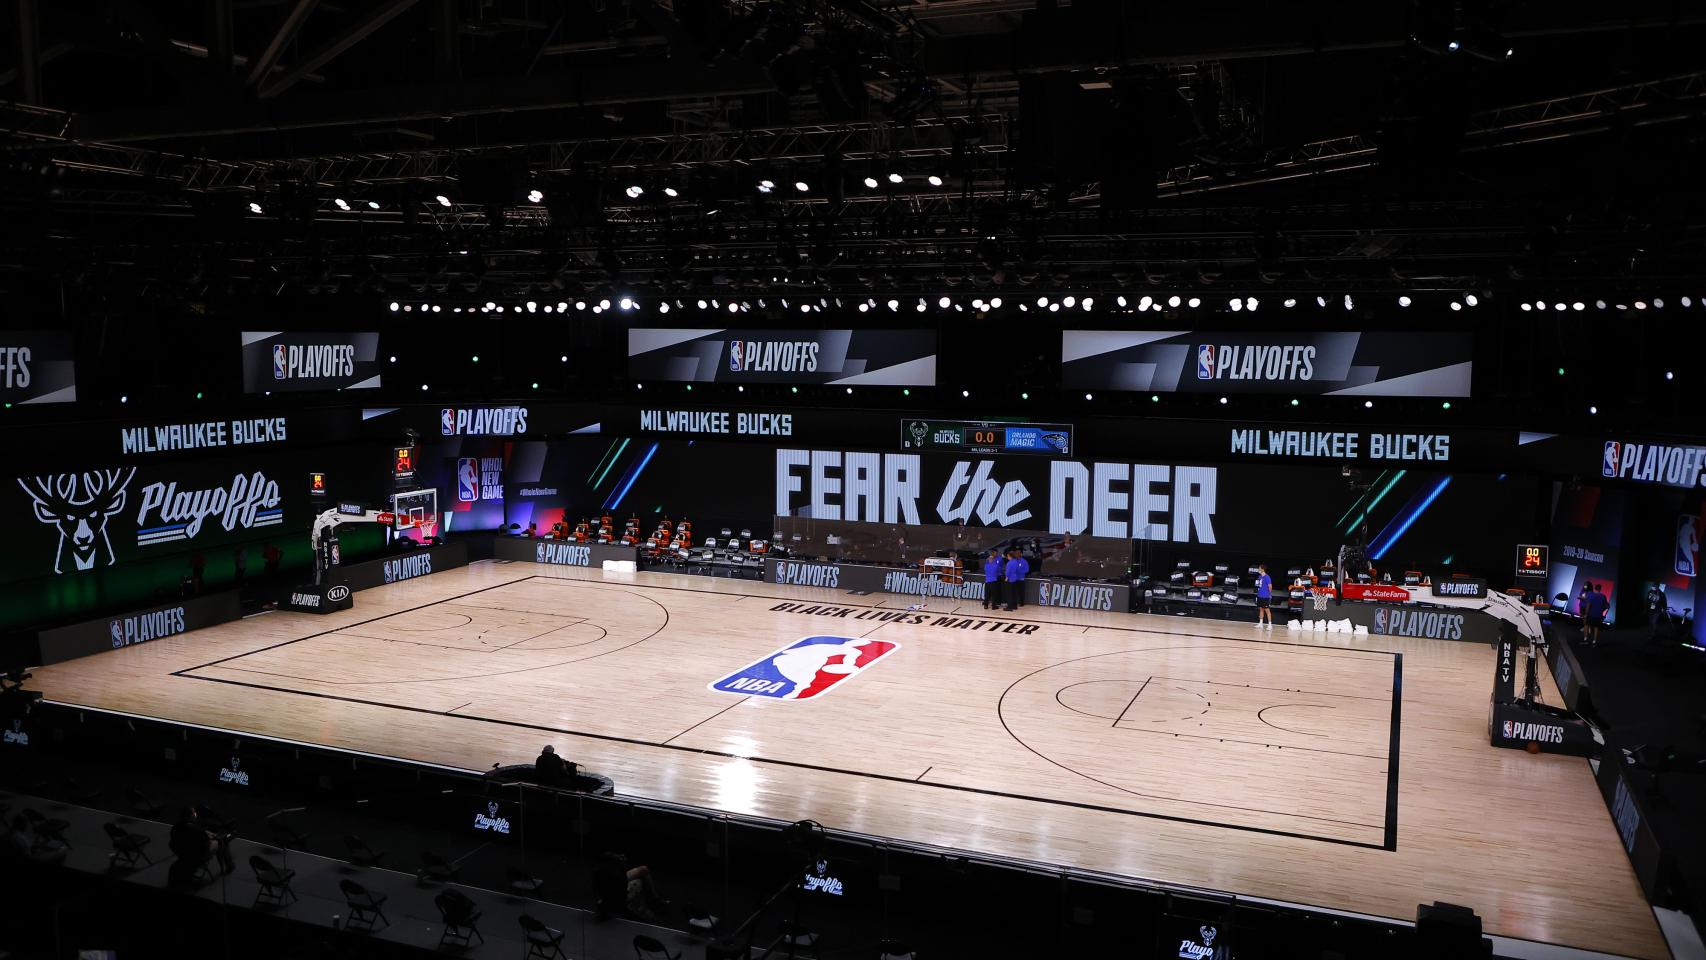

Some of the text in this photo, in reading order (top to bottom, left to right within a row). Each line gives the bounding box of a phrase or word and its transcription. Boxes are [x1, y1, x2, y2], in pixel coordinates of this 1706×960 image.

[288, 345, 354, 378] PLAYOFFS
[744, 341, 819, 372] PLAYOFFS
[1216, 346, 1316, 380] PLAYOFFS
[456, 408, 528, 435] PLAYOFFS
[640, 410, 792, 436] MILWAUKEE BUCKS
[122, 417, 287, 454] MILWAUKEE BUCKS
[934, 431, 994, 443] BUCKS 0.0
[1010, 438, 1035, 447] MAGIC
[1230, 428, 1450, 461] MILWAUKEE BUCKS
[397, 457, 410, 471] 24
[481, 471, 500, 486] NEW
[137, 471, 281, 539] Playoffs
[482, 485, 504, 500] GAME
[776, 448, 1217, 545] FEAR the DEER
[545, 543, 591, 567] PLAYOFFS
[1525, 555, 1540, 567] 24
[1526, 547, 1539, 557] 0.0
[392, 553, 431, 582] PLAYOFFS
[785, 564, 840, 588] PLAYOFFS
[296, 593, 320, 607] PLAYOFFS
[331, 589, 346, 599] KIA
[1050, 585, 1113, 611] PLAYOFFS
[1446, 583, 1478, 595] PLAYOFFS
[124, 607, 185, 645] PLAYOFFS
[769, 602, 1041, 636] BLACK LIVES MATTER
[1388, 609, 1464, 640] PLAYOFFS
[1502, 642, 1511, 683] NBA TV
[725, 677, 787, 694] NBA
[1512, 722, 1564, 744] PLAYOFFS
[805, 873, 843, 894] layoffs
